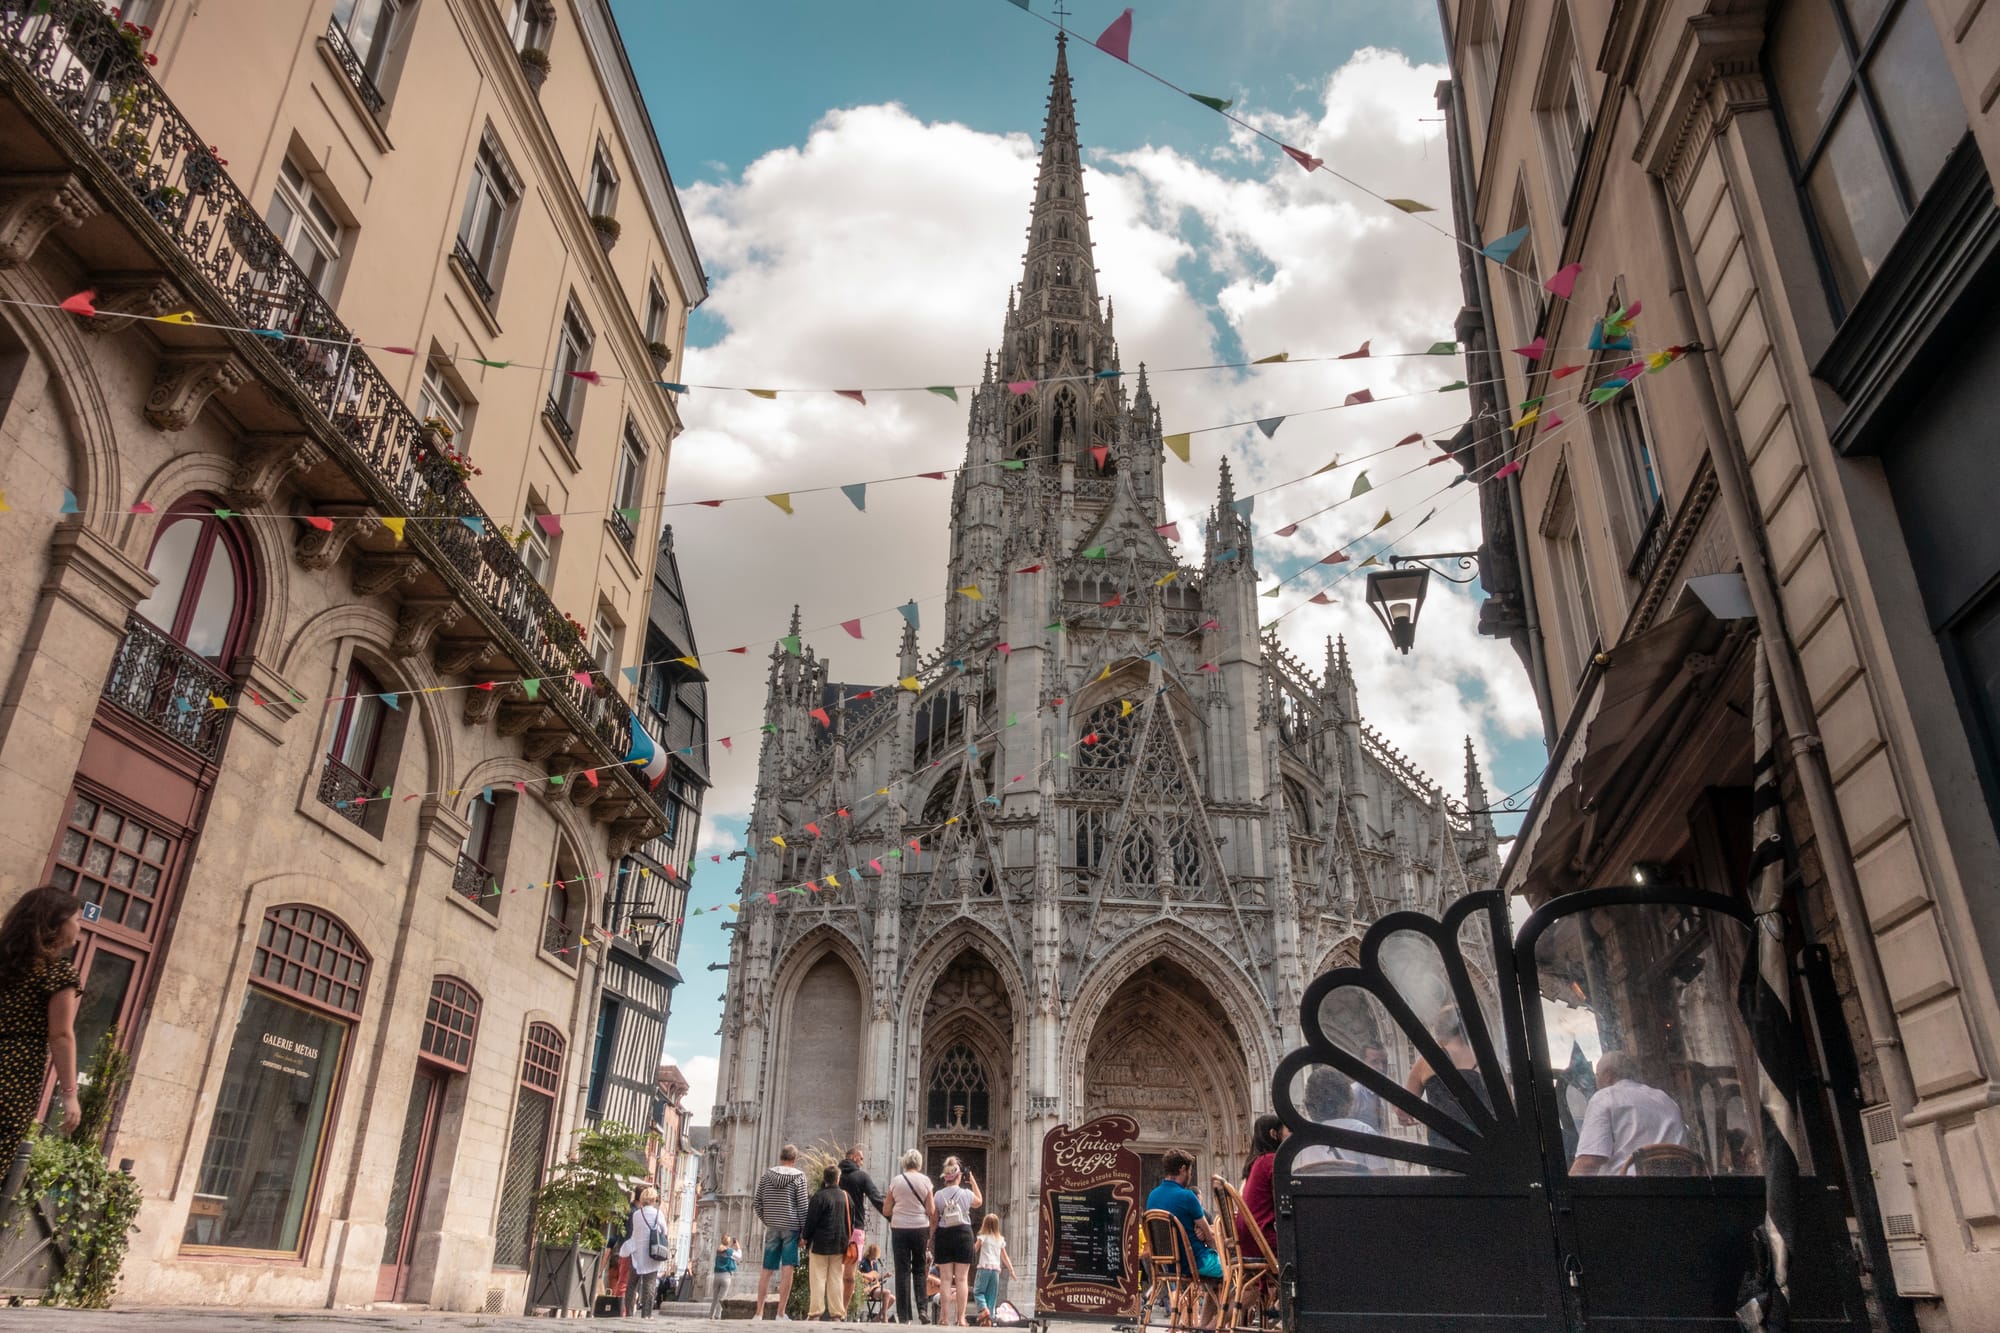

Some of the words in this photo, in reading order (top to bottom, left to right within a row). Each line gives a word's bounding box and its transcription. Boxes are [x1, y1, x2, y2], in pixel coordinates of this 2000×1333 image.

[88, 906, 96, 918] 2
[263, 1033, 294, 1051] GALERIE
[1070, 1131, 1121, 1153] Antico
[1064, 1176, 1090, 1187] Service
[1067, 1295, 1106, 1305] BRUNCH
